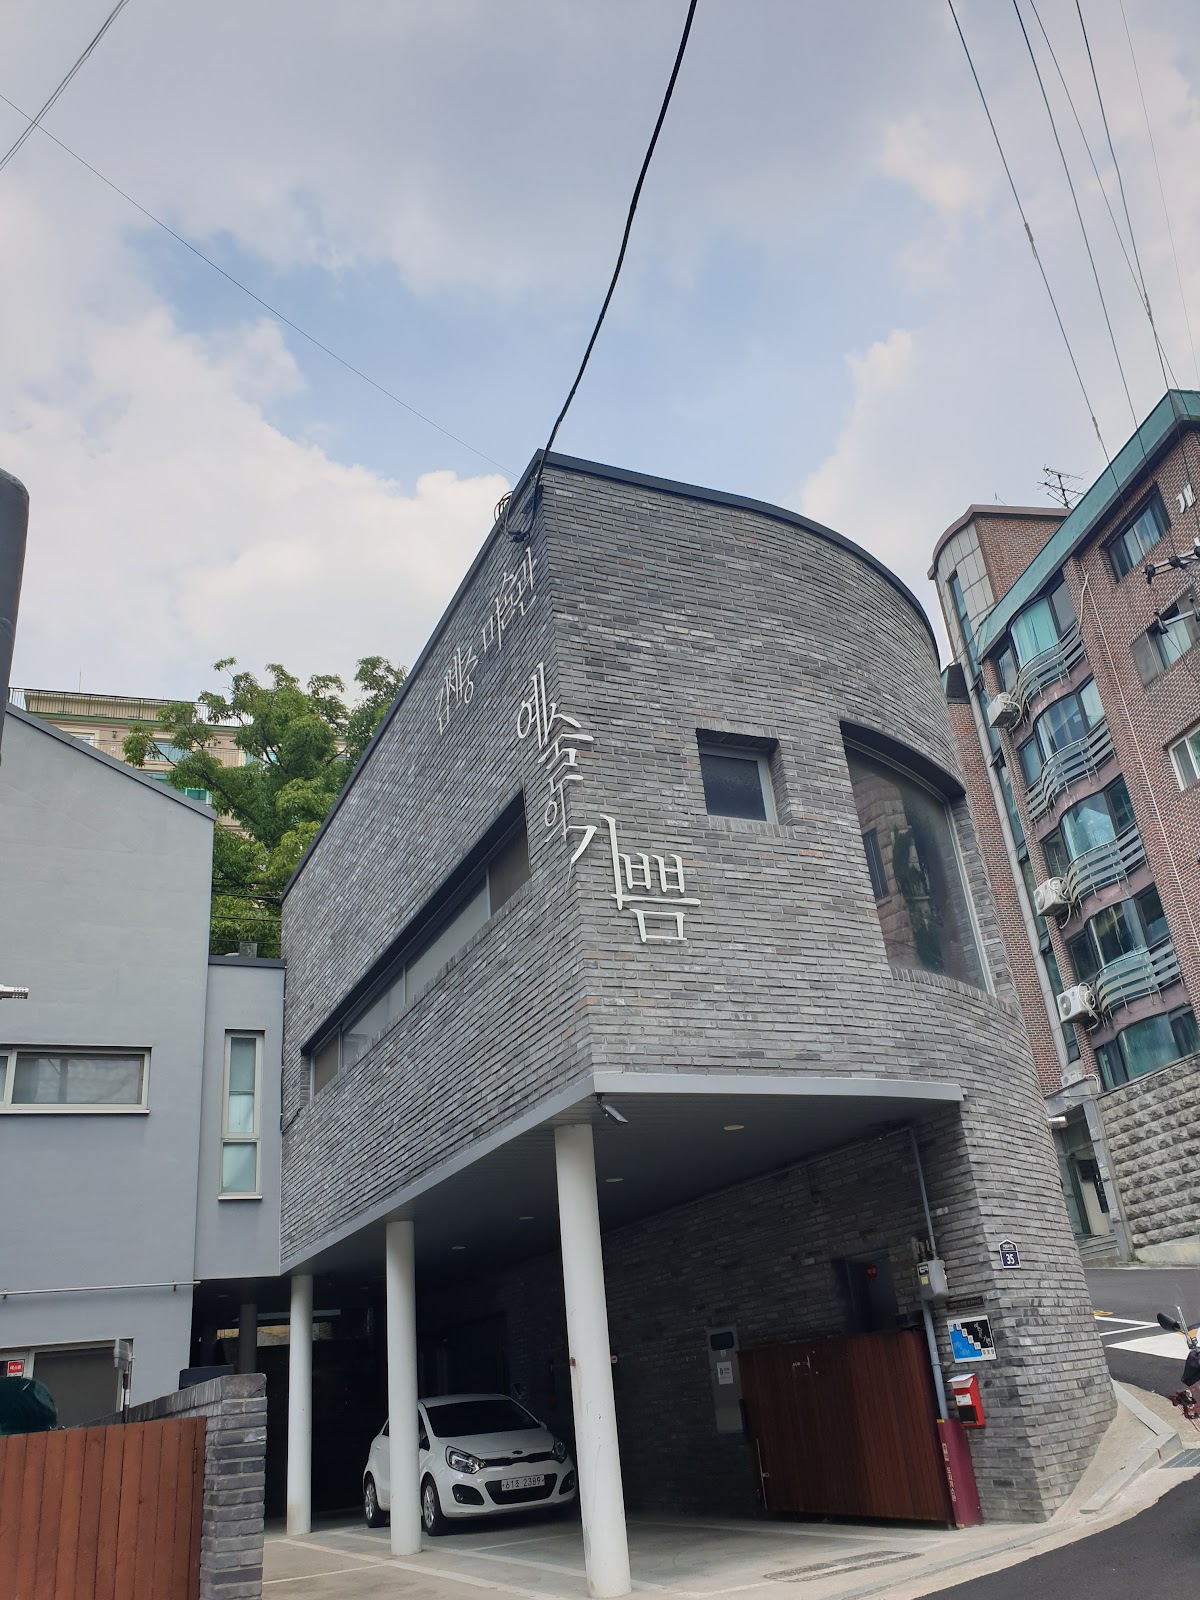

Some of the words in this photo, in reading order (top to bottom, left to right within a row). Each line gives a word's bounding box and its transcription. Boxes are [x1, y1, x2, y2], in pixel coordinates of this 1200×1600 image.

[435, 647, 479, 735] 김세중
[481, 546, 537, 653] 미술관
[517, 661, 594, 842] 예술의
[564, 814, 701, 943] 기쁨
[1006, 1253, 1015, 1265] 35
